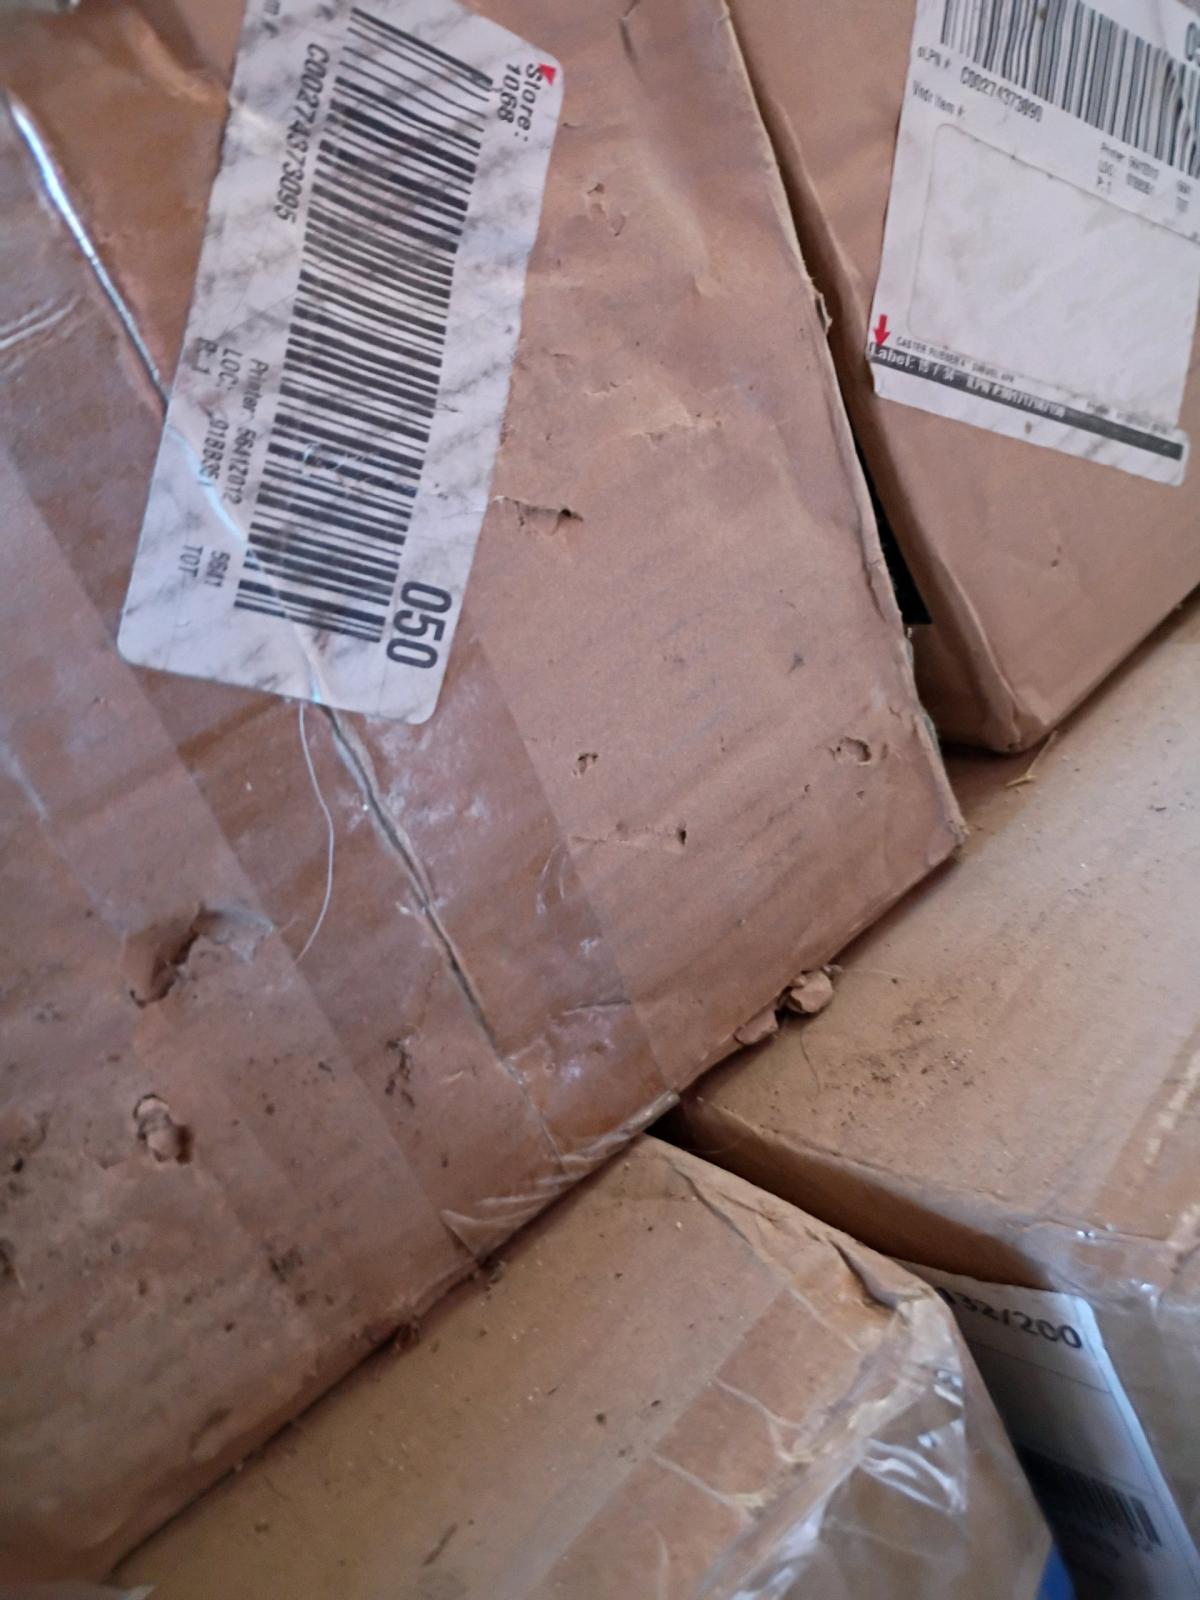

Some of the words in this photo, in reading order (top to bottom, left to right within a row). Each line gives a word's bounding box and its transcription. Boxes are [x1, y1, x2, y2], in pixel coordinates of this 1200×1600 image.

[497, 63, 523, 124] 1068
[514, 63, 543, 142] Store:
[273, 43, 329, 224] C00274373095
[870, 342, 914, 369] Label:
[386, 581, 452, 669] 050
